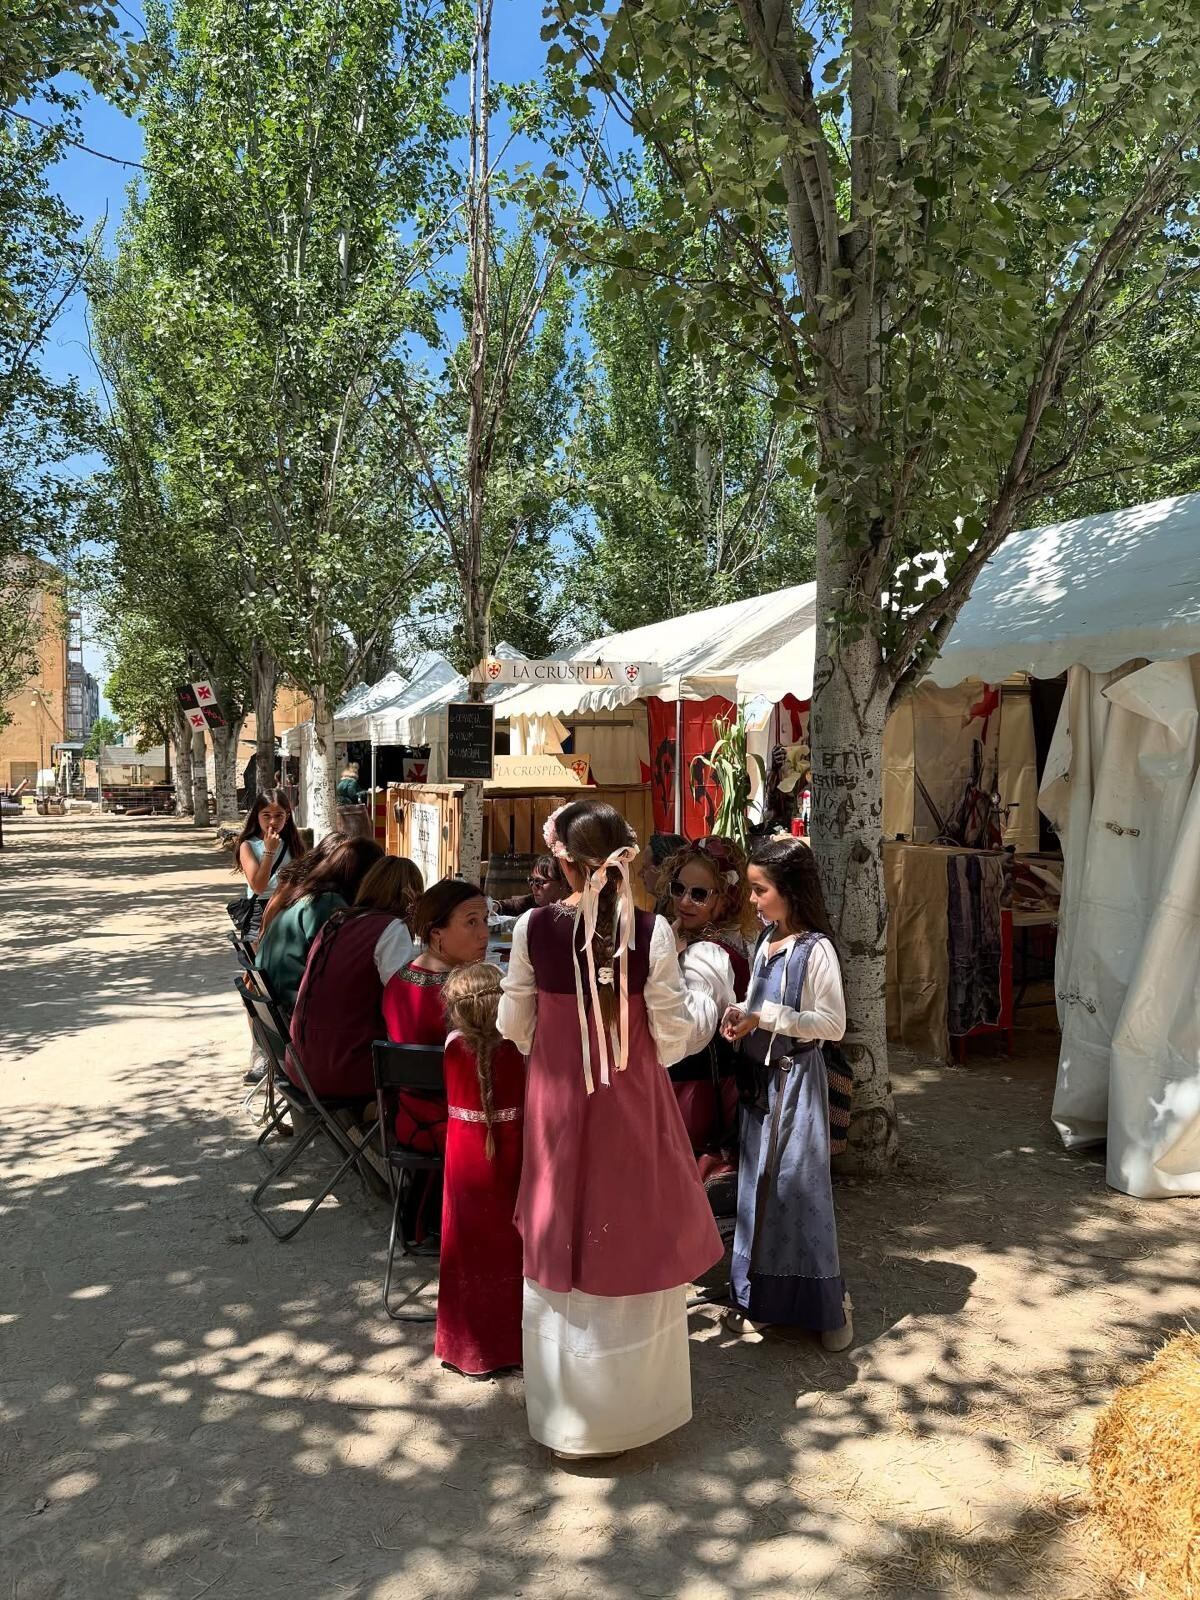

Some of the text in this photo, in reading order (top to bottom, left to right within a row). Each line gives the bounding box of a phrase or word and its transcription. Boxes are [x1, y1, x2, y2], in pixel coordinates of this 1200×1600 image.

[513, 665, 614, 679] LA CRUSPIDA
[498, 766, 510, 777] LA
[513, 765, 569, 777] CRUSPIDA
